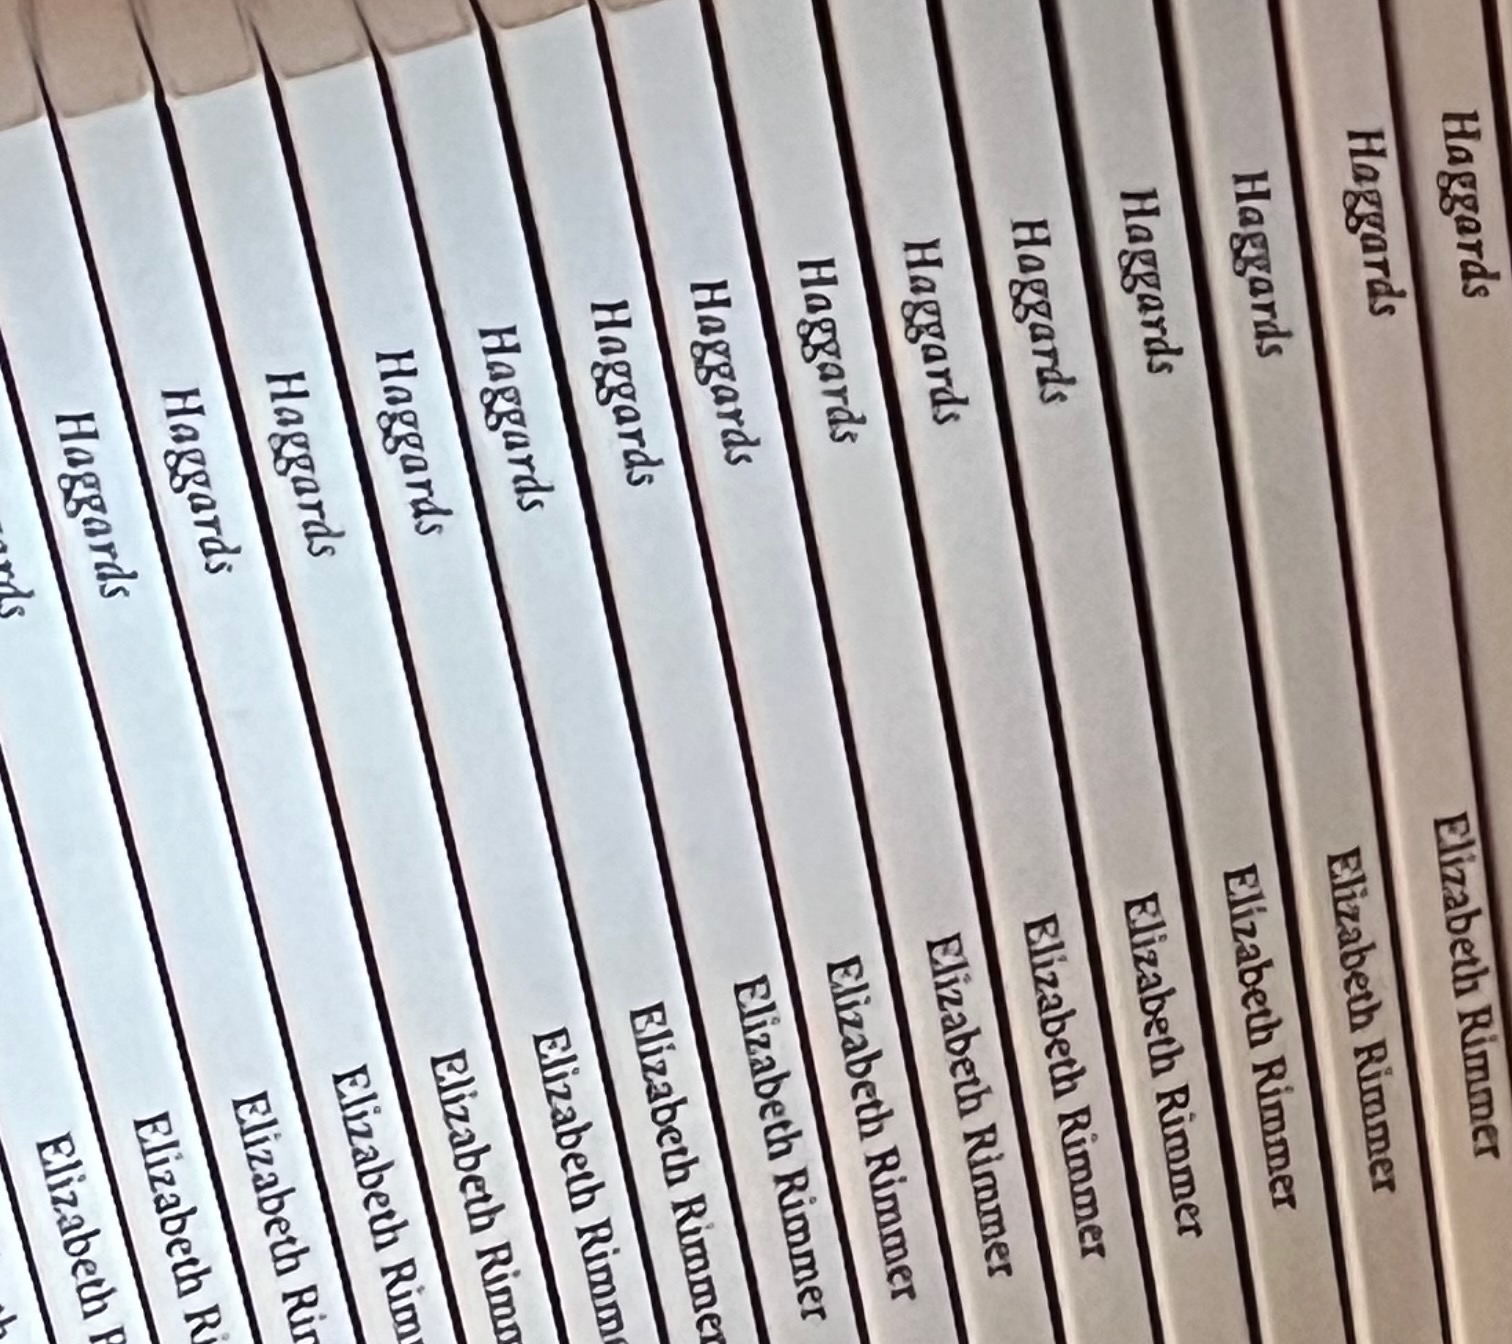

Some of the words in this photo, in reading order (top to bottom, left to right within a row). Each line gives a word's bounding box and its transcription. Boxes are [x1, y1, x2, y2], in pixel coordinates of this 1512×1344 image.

[1116, 186, 1185, 375] Haggards
[1228, 169, 1295, 359] Haggards
[1341, 127, 1408, 317] Haggards
[1435, 109, 1502, 299] Haggards
[589, 298, 666, 487] Haggards
[689, 278, 762, 467] Haggards
[795, 256, 868, 444] Haggards
[899, 237, 971, 427] Haggards
[1007, 218, 1078, 406] Haggards
[54, 411, 139, 599] Haggards
[160, 386, 243, 575] Haggards
[264, 370, 347, 558] Haggards
[374, 348, 455, 537] Haggards
[477, 323, 556, 513] Haggards
[1222, 862, 1284, 1051] Elizabeth
[1326, 844, 1383, 1035] Elizabeth
[1432, 810, 1491, 1000] Elizabeth
[331, 1062, 410, 1254] Elizabeth
[429, 1047, 507, 1236] Elizabeth
[531, 1025, 607, 1215] Elizabeth
[628, 999, 701, 1190] Elizabeth
[732, 973, 804, 1162] Elizabeth
[771, 1164, 828, 1322] Rimmer
[825, 953, 895, 1144] Elizabeth
[863, 1143, 918, 1302] Rimmer
[925, 931, 994, 1121] Elizabeth
[962, 1121, 1014, 1279] Rimmer
[1022, 911, 1088, 1102] Elizabeth
[1056, 1103, 1107, 1260] Rimmer
[1122, 890, 1186, 1080] Elizabeth
[1154, 1081, 1204, 1239] Rimmer
[1251, 1053, 1297, 1211] Rimmer
[1352, 1037, 1397, 1194] Rimmer
[1456, 1003, 1501, 1160] Rimmer
[35, 1130, 119, 1322] Elizabeth
[132, 1109, 213, 1300] Elizabeth
[230, 1089, 312, 1279] Elizabeth
